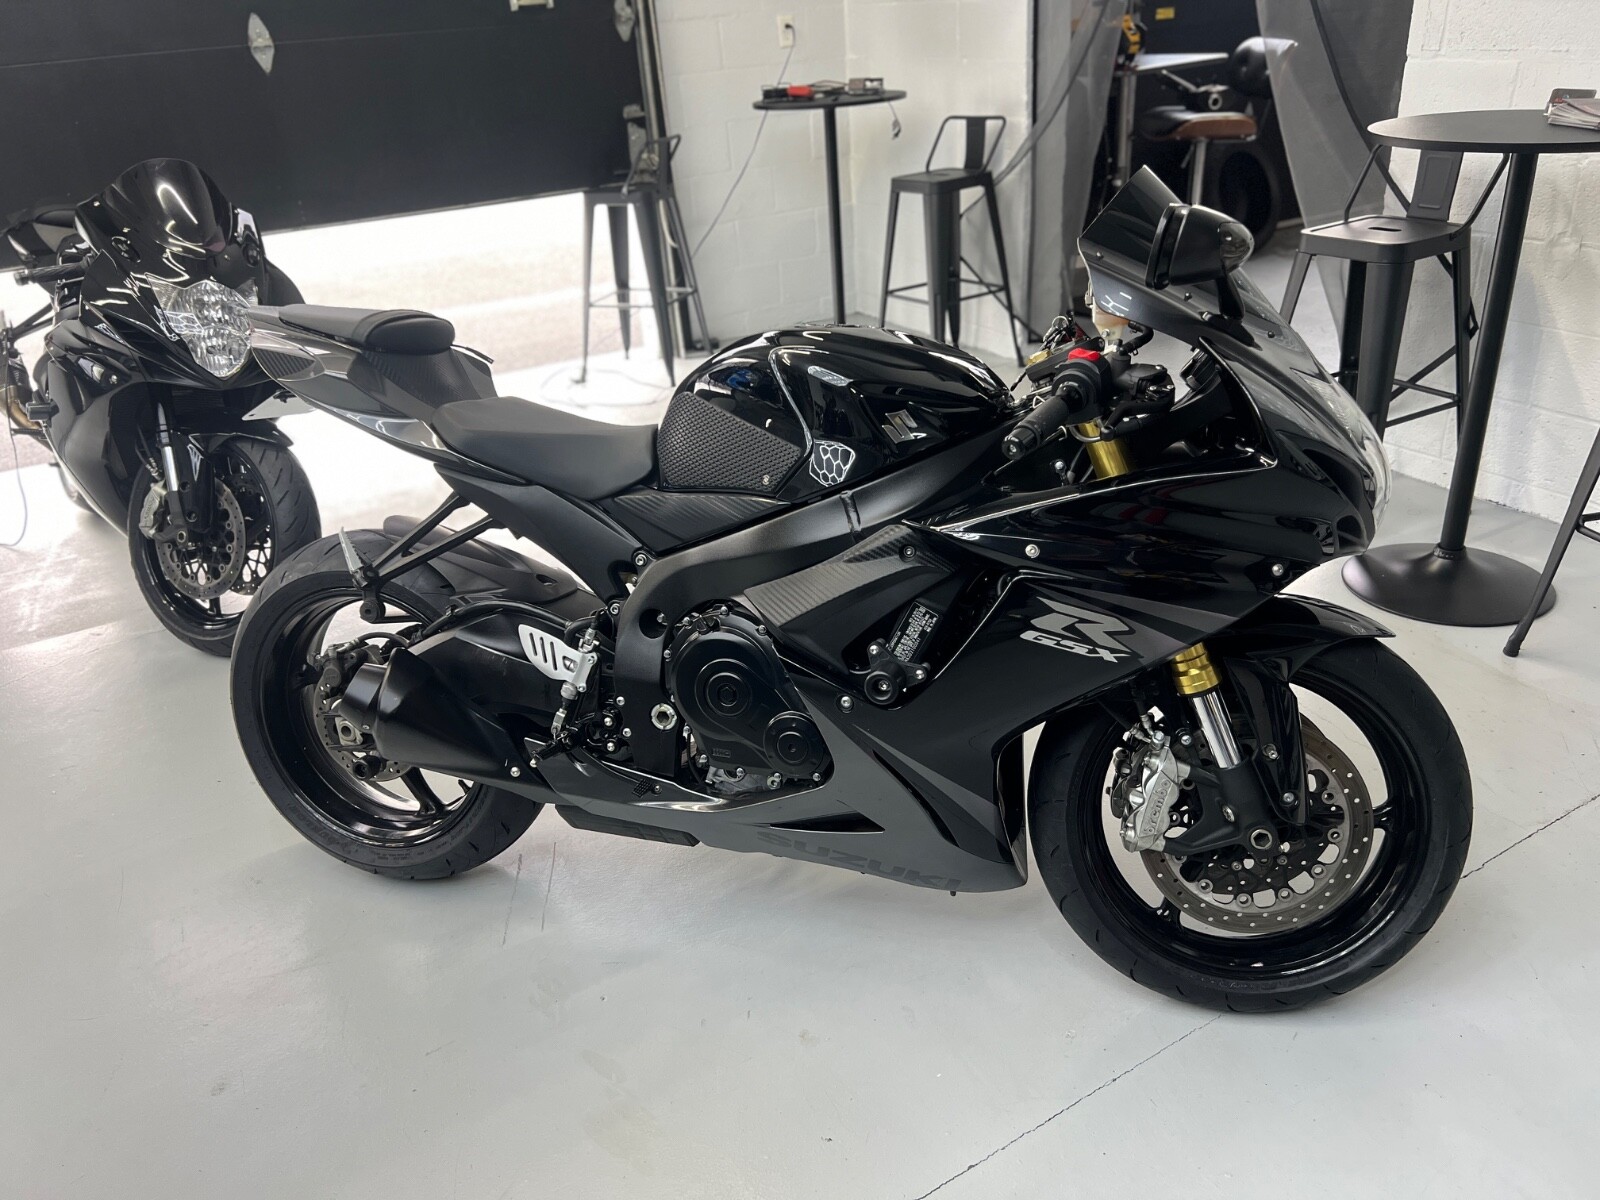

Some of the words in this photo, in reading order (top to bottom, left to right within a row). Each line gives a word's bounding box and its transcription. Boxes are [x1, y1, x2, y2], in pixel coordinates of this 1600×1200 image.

[1019, 630, 1131, 663] GSX
[1142, 778, 1171, 834] brembo
[756, 830, 962, 890] SUZUKI
